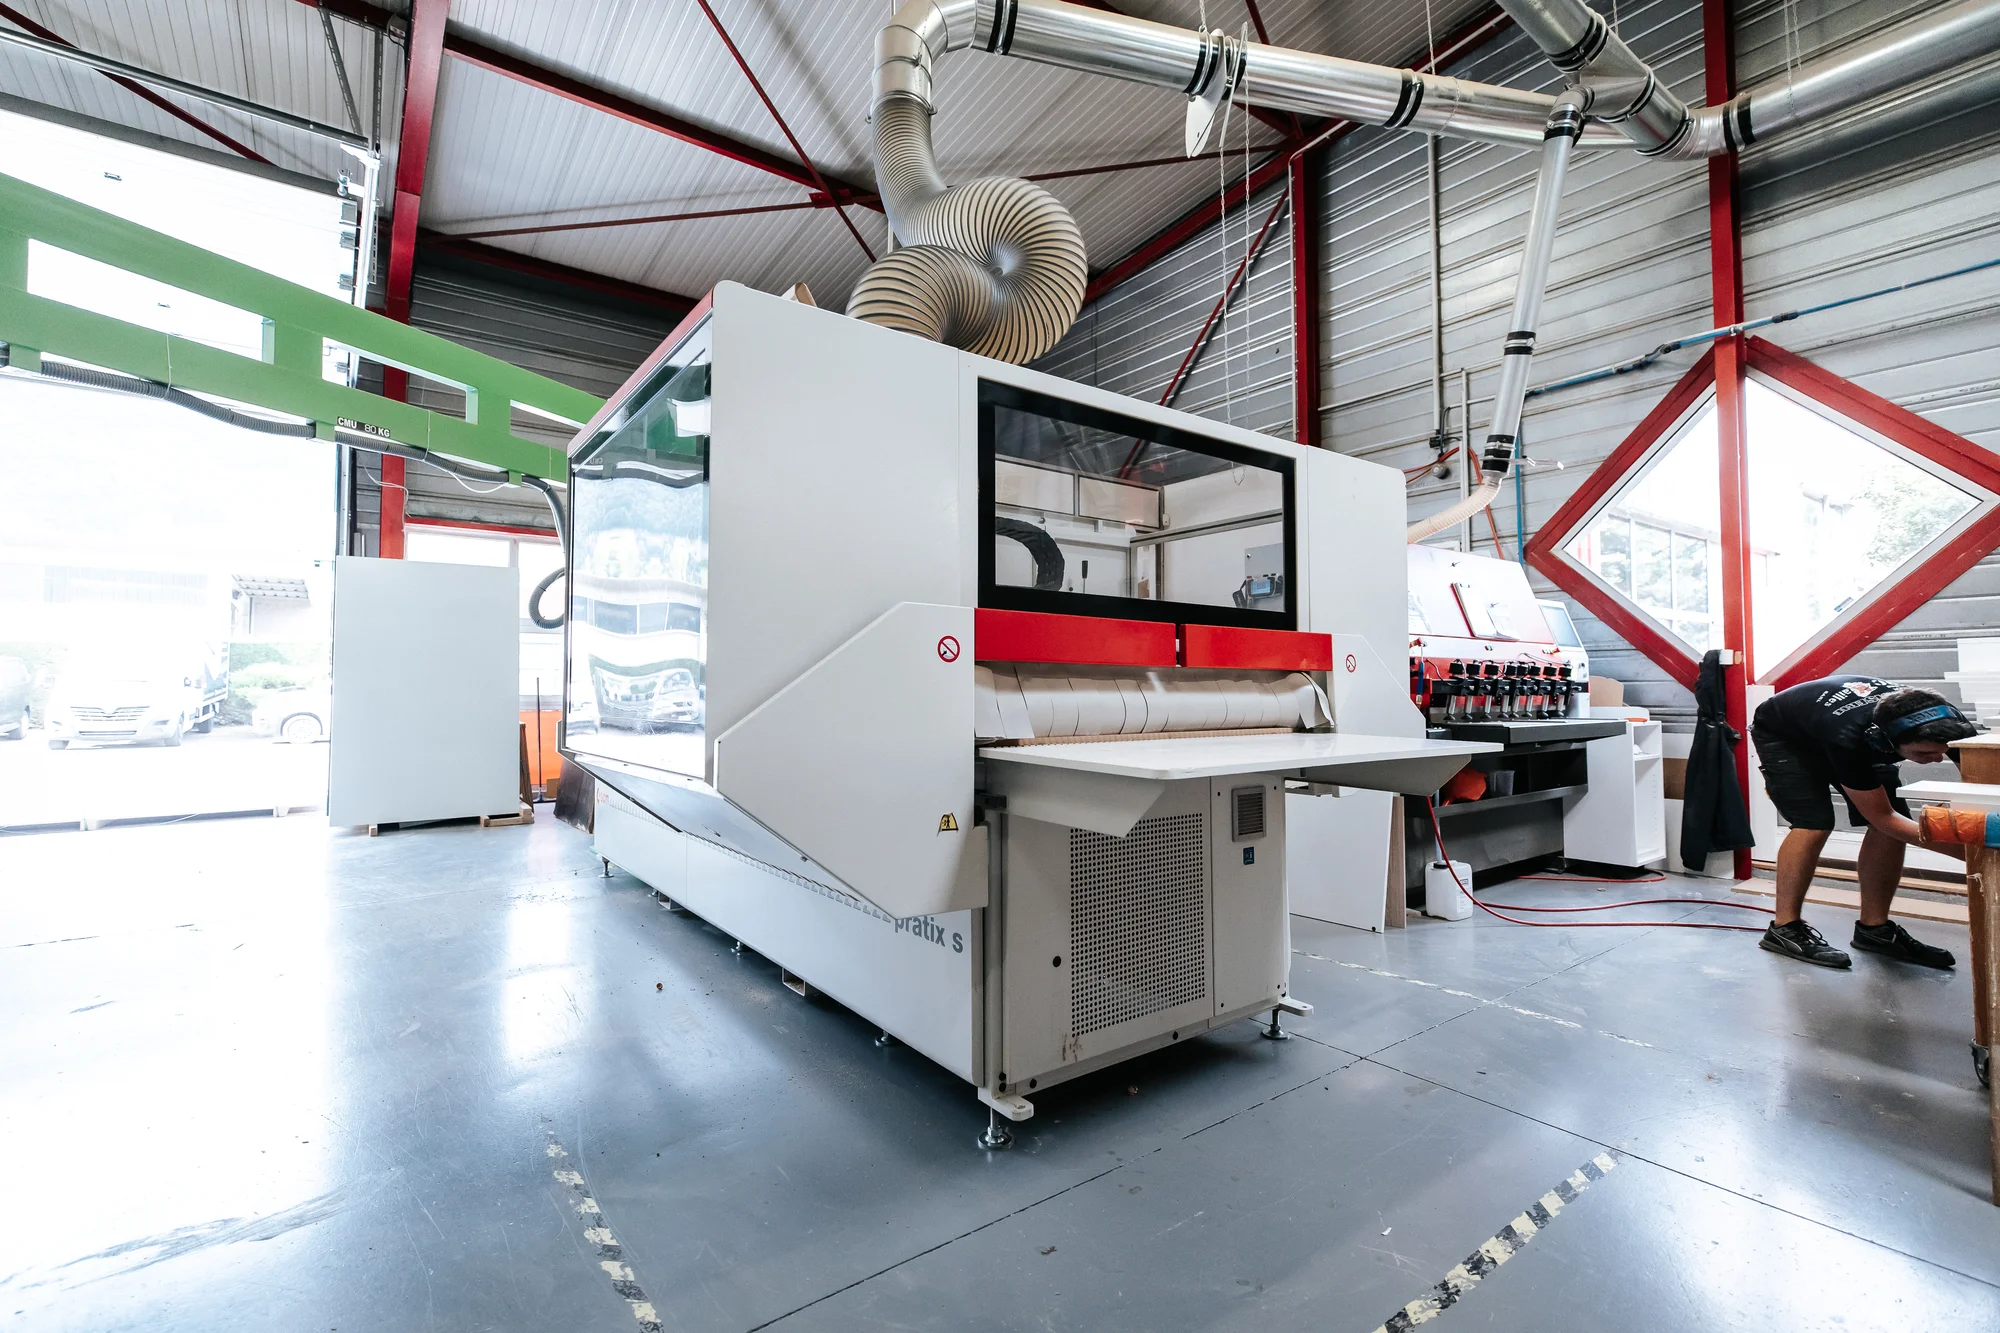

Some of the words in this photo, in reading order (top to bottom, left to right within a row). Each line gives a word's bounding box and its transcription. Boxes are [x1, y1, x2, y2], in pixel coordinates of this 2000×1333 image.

[338, 417, 357, 428] CMU
[364, 423, 377, 434] 80
[378, 427, 390, 437] KG
[894, 916, 946, 947] pratix
